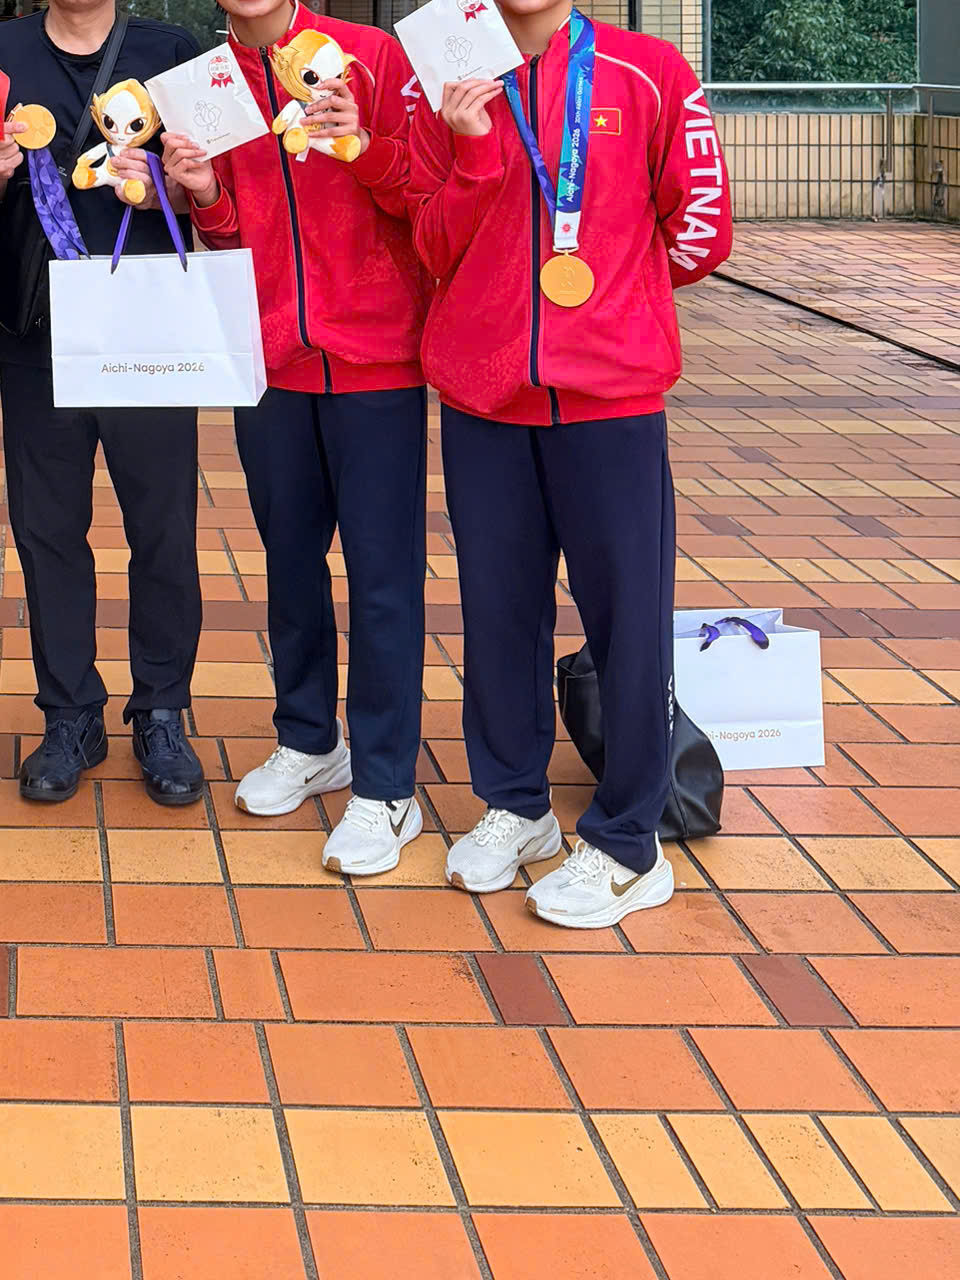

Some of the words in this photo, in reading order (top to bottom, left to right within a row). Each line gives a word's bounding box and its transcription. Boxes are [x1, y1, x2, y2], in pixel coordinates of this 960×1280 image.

[571, 128, 581, 148] 2026
[566, 149, 580, 202] Aichi-Nagoya
[668, 87, 723, 271] VIETNAM
[101, 363, 175, 375] Aichi-Nagoya
[177, 363, 205, 372] 2026
[758, 729, 781, 738] 2026
